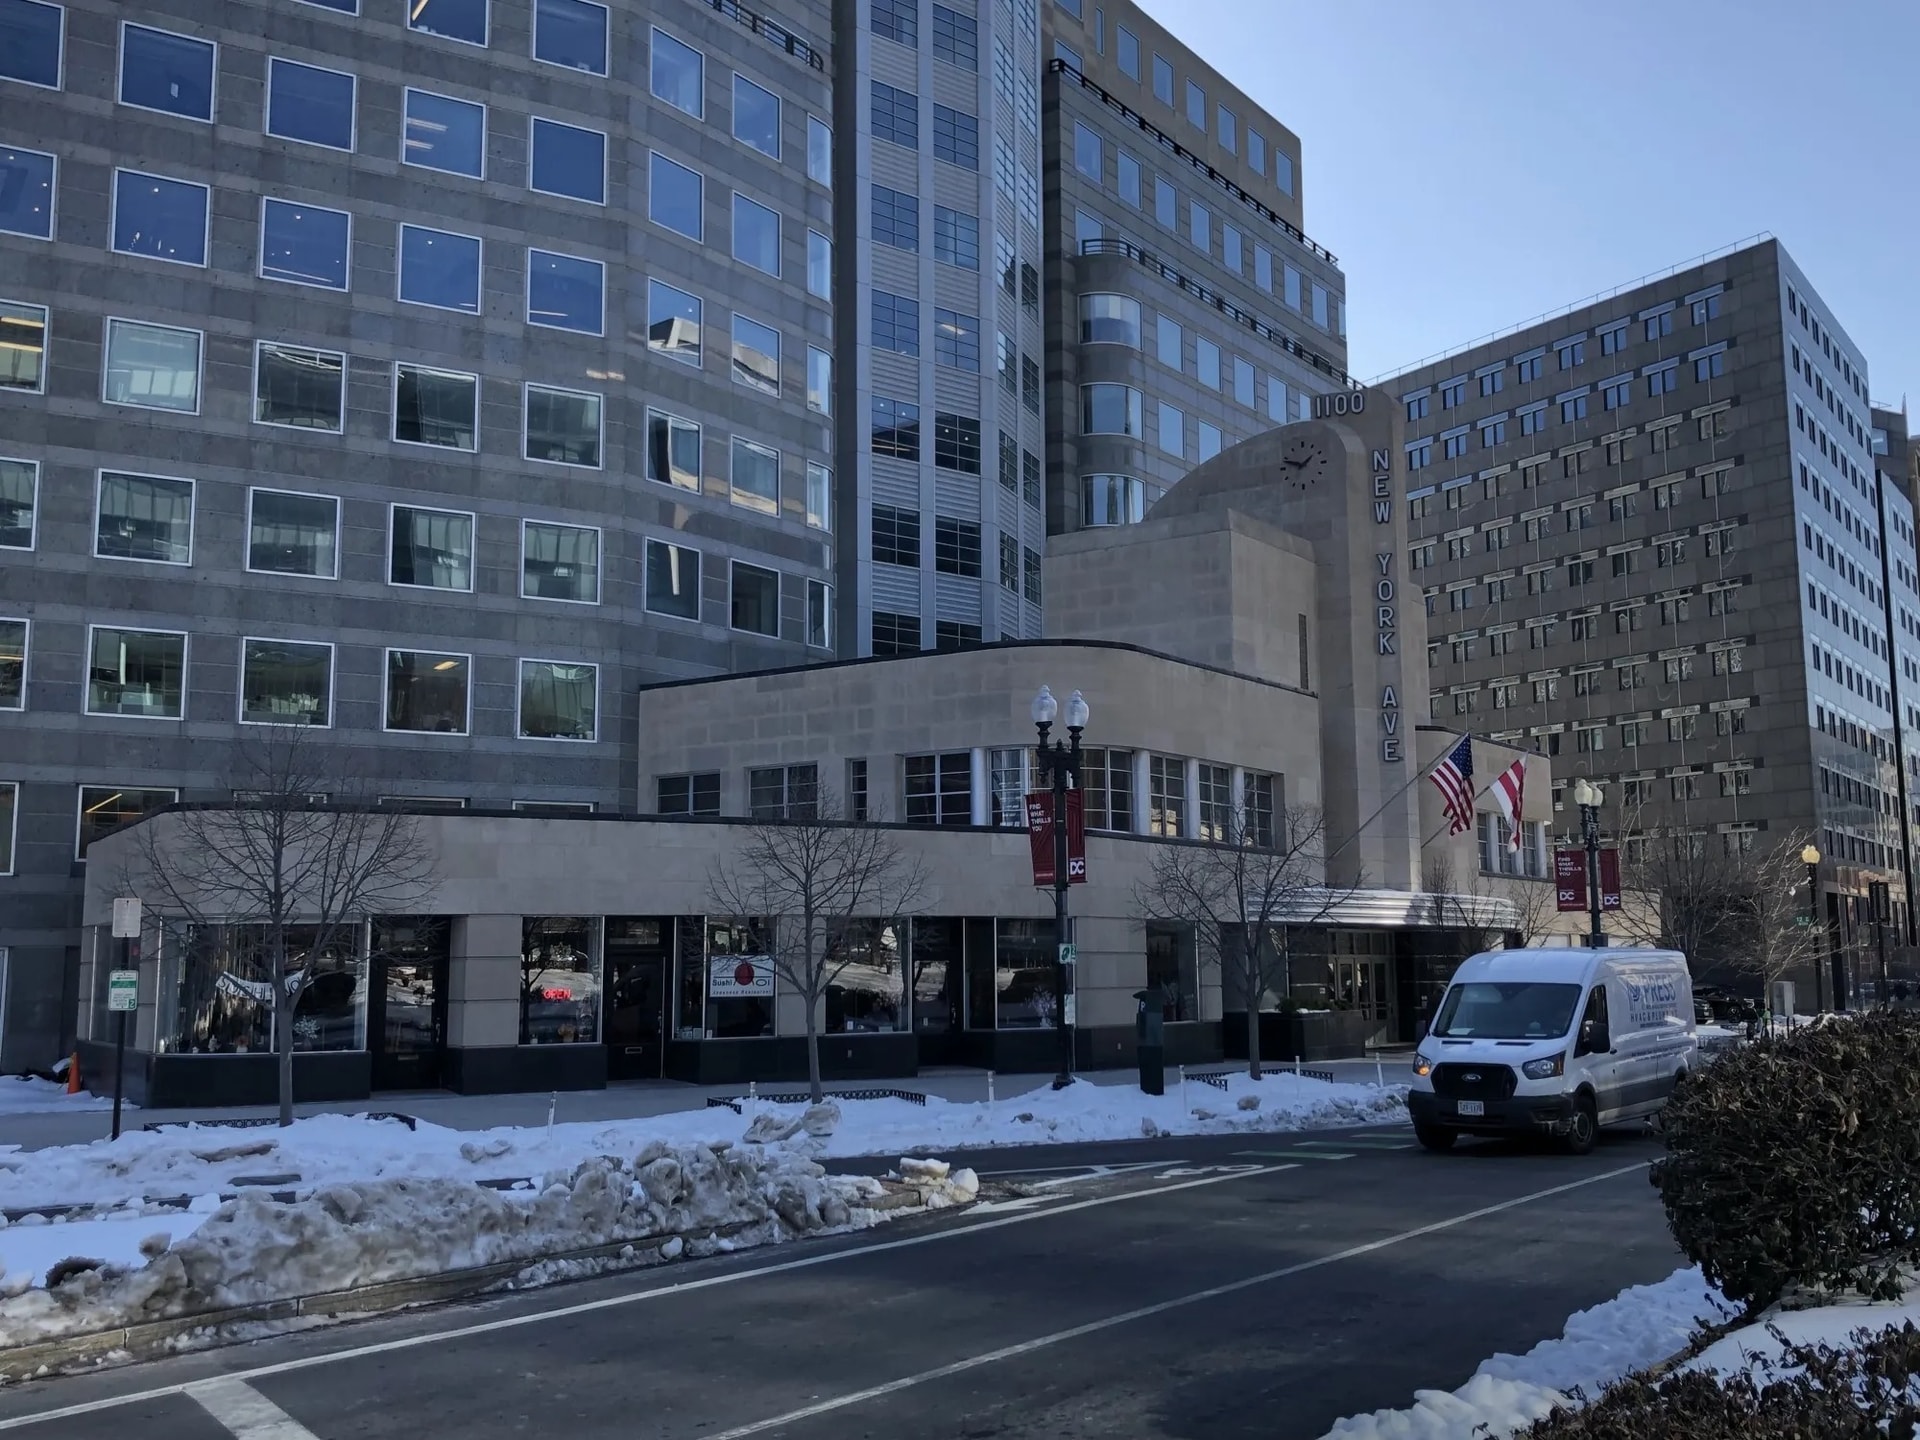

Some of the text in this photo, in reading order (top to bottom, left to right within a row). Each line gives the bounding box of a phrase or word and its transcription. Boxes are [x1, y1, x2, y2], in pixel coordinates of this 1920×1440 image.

[1316, 392, 1364, 417] 1100
[1373, 448, 1399, 762] NEW YORK AVE
[1069, 860, 1085, 875] DC
[1560, 891, 1575, 901] DC
[1604, 896, 1620, 905] DC
[544, 989, 571, 999] OPEN
